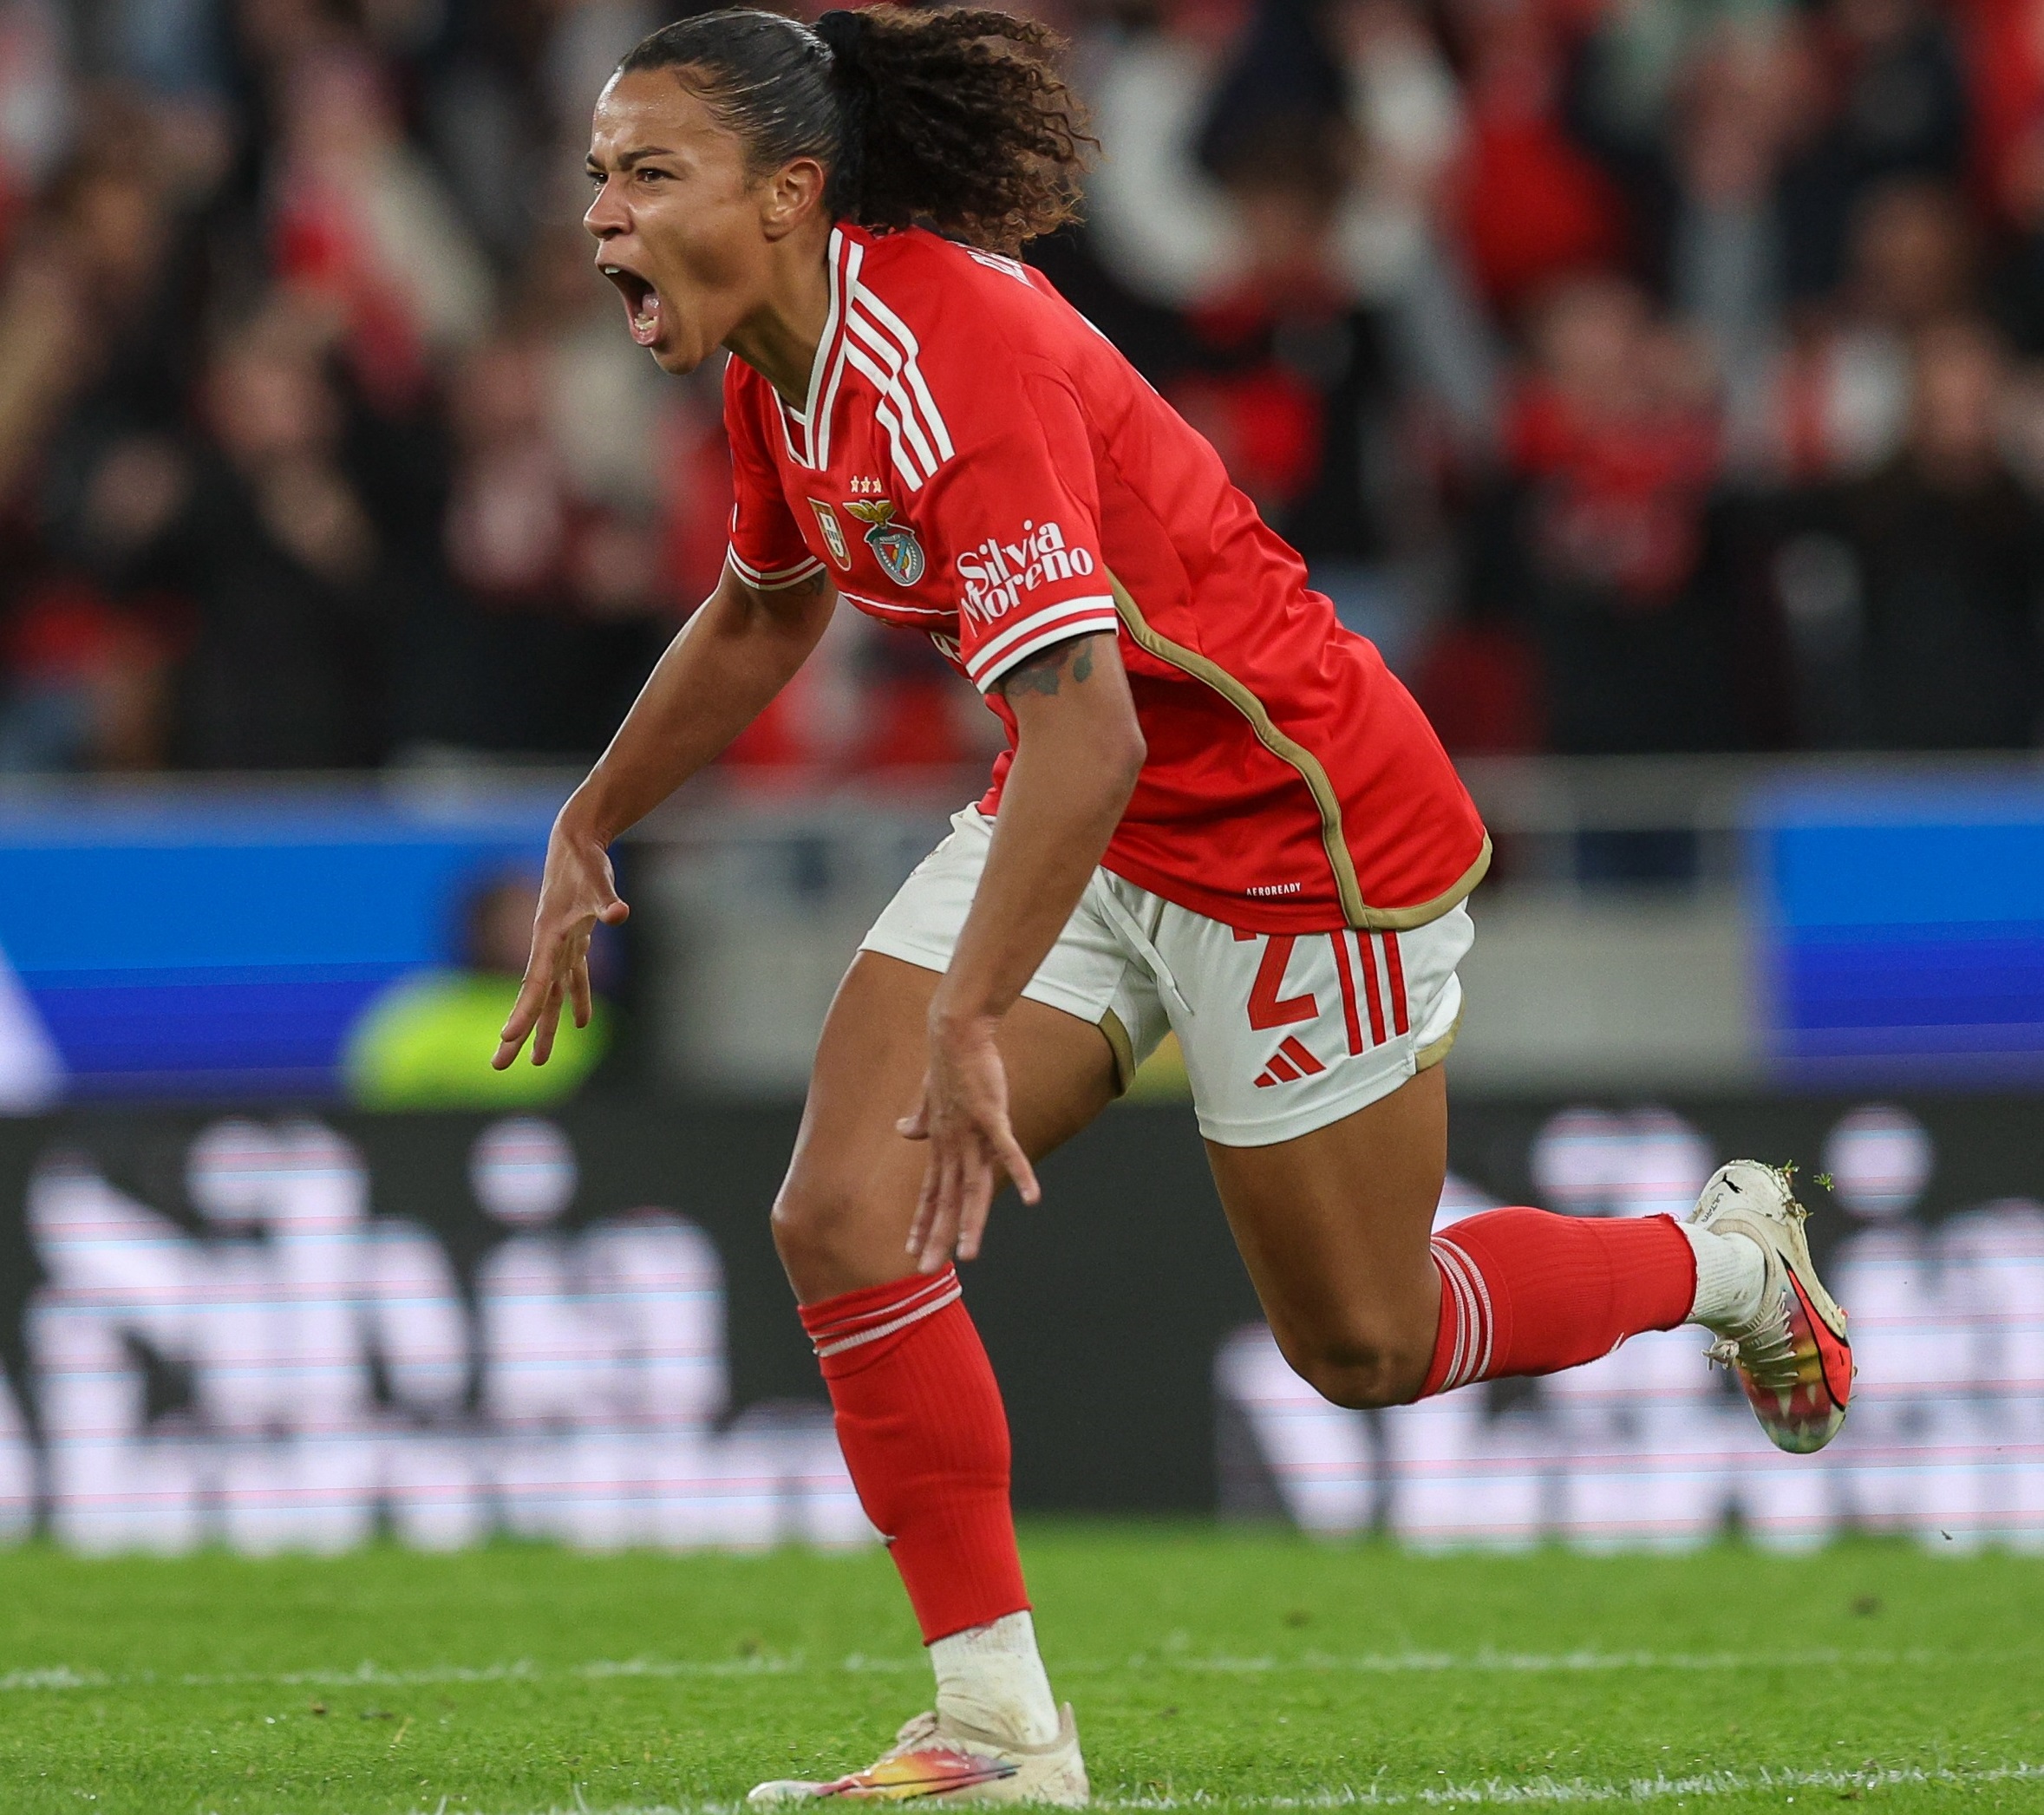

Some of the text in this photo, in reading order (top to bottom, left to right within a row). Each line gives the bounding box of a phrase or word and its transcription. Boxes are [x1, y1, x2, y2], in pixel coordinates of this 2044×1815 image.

[957, 519, 1065, 594] Silvia
[960, 547, 1094, 638] Moreno
[1246, 882, 1301, 896] AEROREADY
[1231, 926, 1319, 1031] 2
[1701, 1192, 1724, 1223] ULTRA
